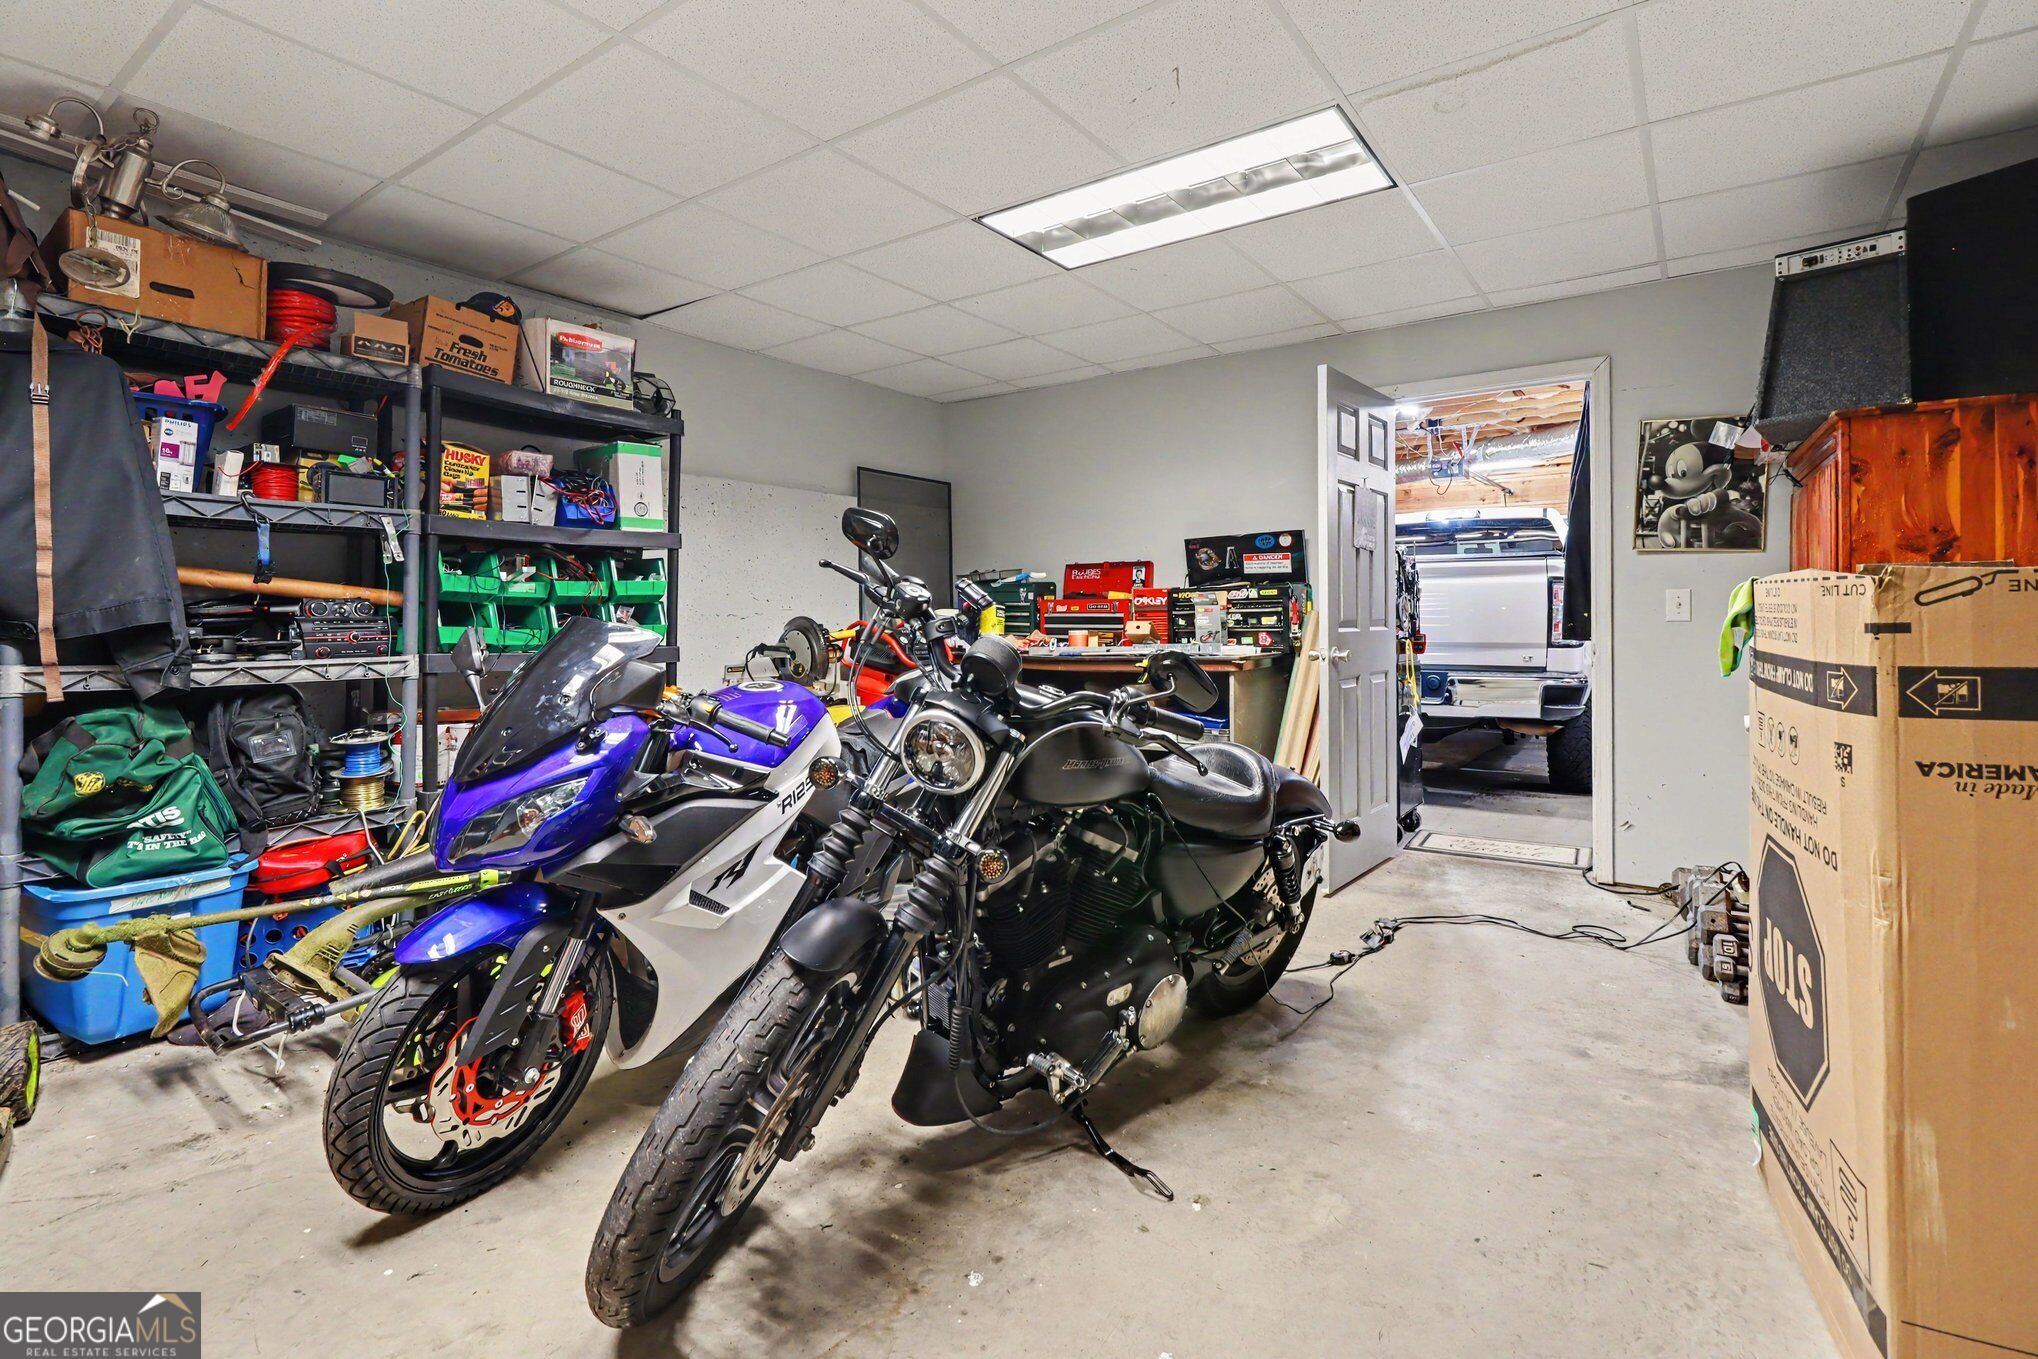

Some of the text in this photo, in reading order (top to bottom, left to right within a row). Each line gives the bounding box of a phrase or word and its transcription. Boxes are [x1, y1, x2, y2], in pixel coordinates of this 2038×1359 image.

[434, 347, 499, 377] Tomatoes
[449, 341, 488, 362] Fresh
[553, 379, 596, 393] ROUGHNECK
[444, 447, 487, 467] HUSKY
[1134, 596, 1168, 606] OAKLEY
[1820, 583, 1867, 598] CUT LINE
[1953, 781, 1978, 798] in
[1774, 811, 1801, 847] HANDLE
[1803, 833, 1820, 860] NOT
[1823, 847, 1838, 872] DO
[1763, 917, 1814, 1030] STOP
